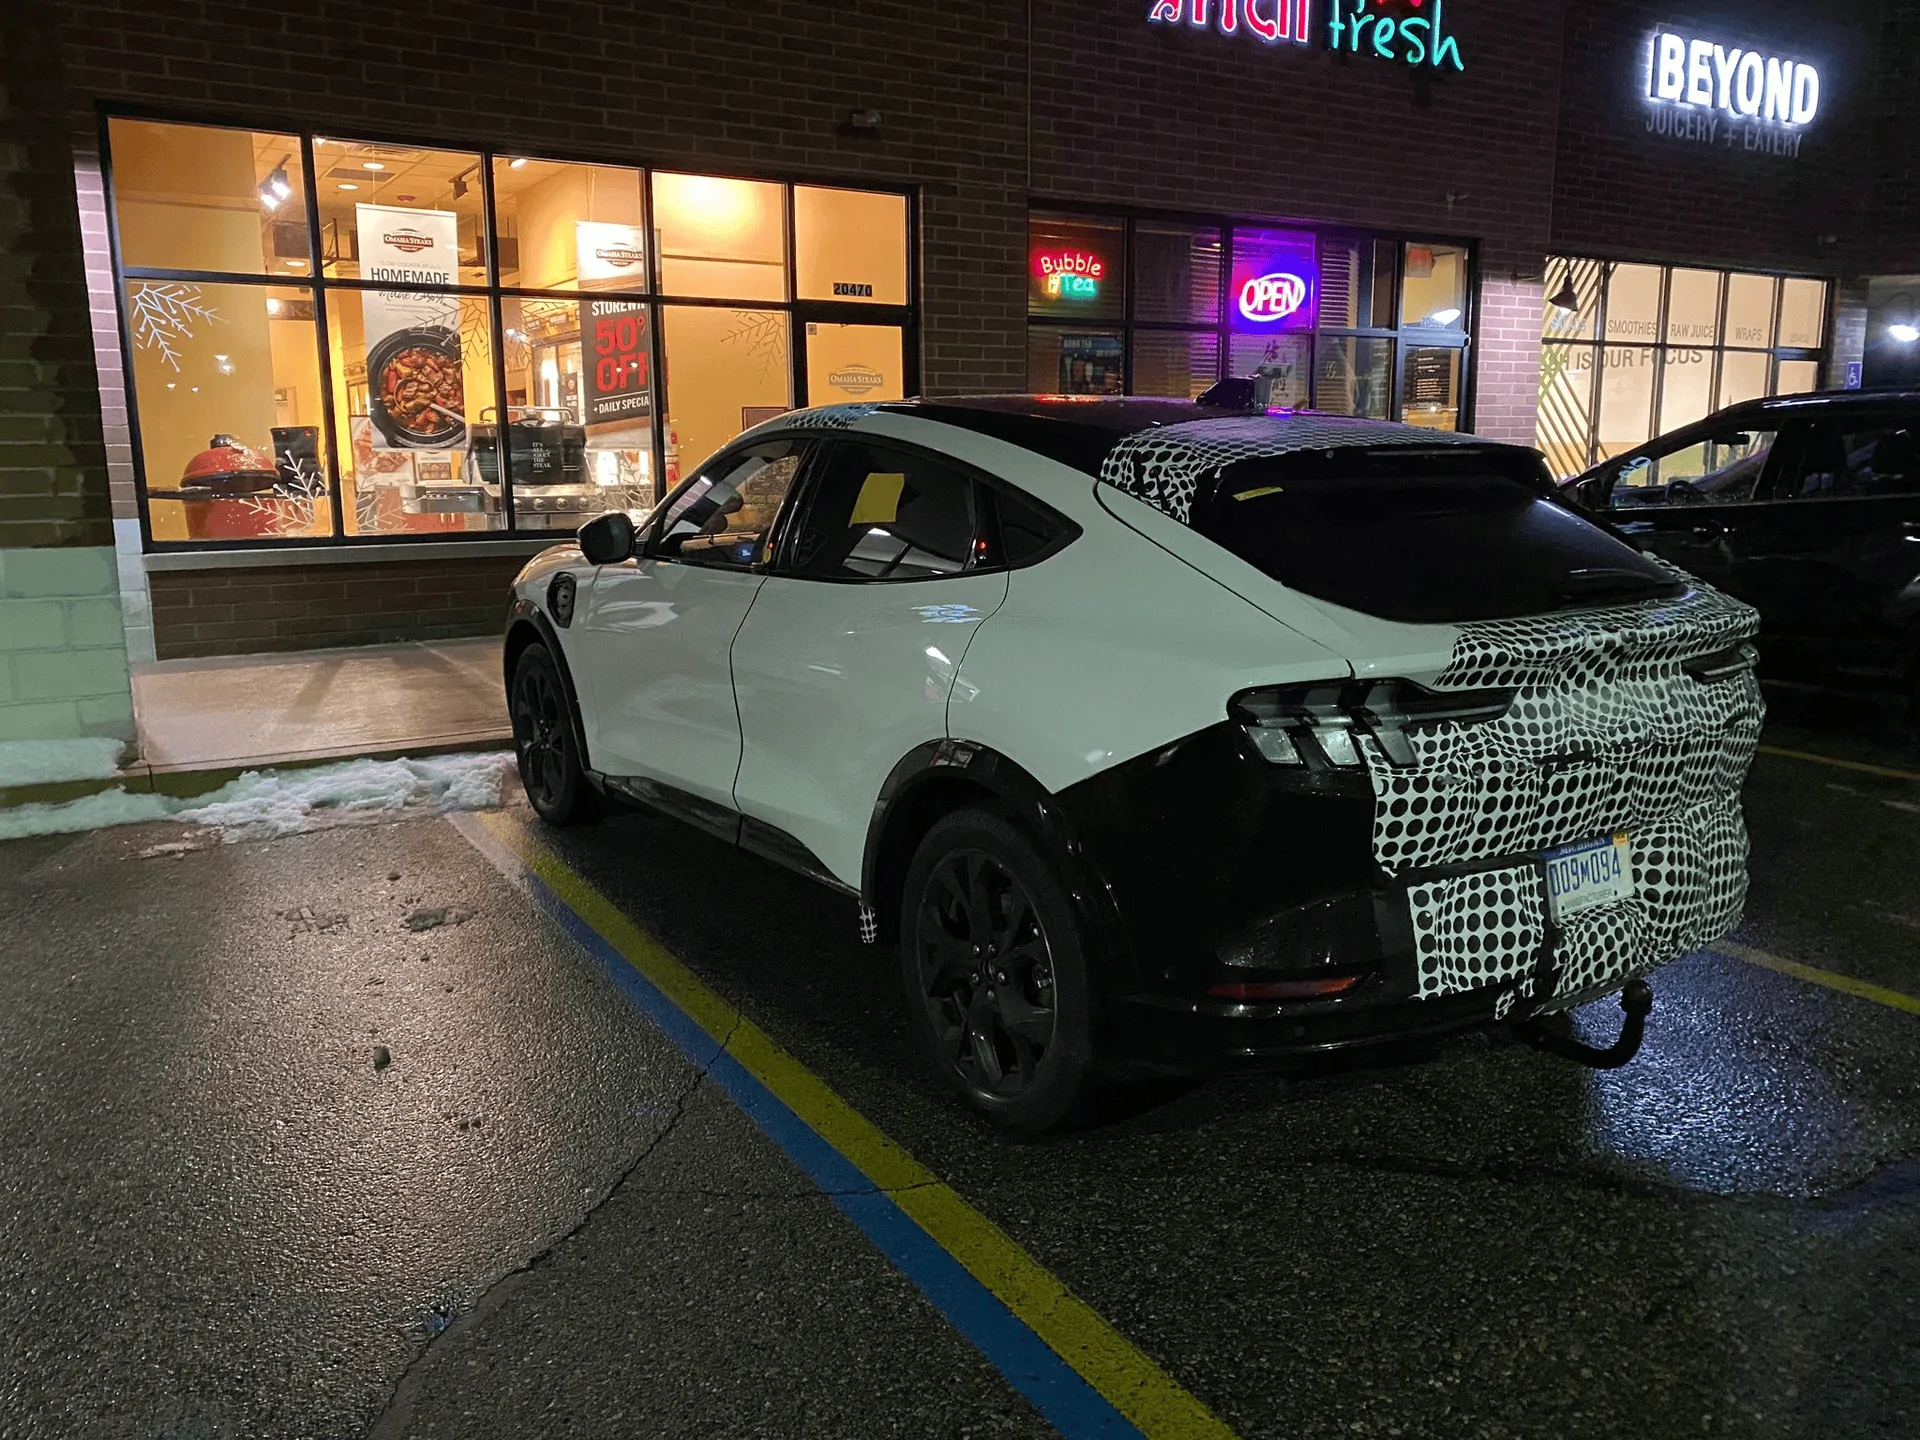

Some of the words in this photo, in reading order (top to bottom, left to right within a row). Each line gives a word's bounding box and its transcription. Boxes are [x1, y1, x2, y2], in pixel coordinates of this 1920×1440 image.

[1329, 0, 1464, 71] fresh
[1652, 33, 1820, 124] BEYOND
[1646, 107, 1718, 144] JUICERY
[1744, 124, 1802, 158] EATERY
[384, 235, 410, 244] OMAHA
[410, 237, 432, 246] STEAKS
[596, 250, 621, 258] OMAHA
[1040, 252, 1101, 275] Bubble
[371, 267, 450, 285] HOMEMADE
[1061, 274, 1095, 293] Tea
[833, 282, 873, 297] 20470
[1241, 279, 1300, 312] OPEN
[592, 301, 646, 316] STOREWI
[1607, 319, 1657, 335] SMOOTHIES
[1670, 324, 1689, 337] RAW
[1735, 327, 1763, 341] WRAPS
[1576, 351, 1592, 370] IS
[1640, 347, 1703, 367] FCUS
[830, 374, 857, 383] OMAHA
[857, 375, 881, 384] STEAKS
[599, 401, 621, 414] DAILY
[622, 396, 650, 410] SPECIA
